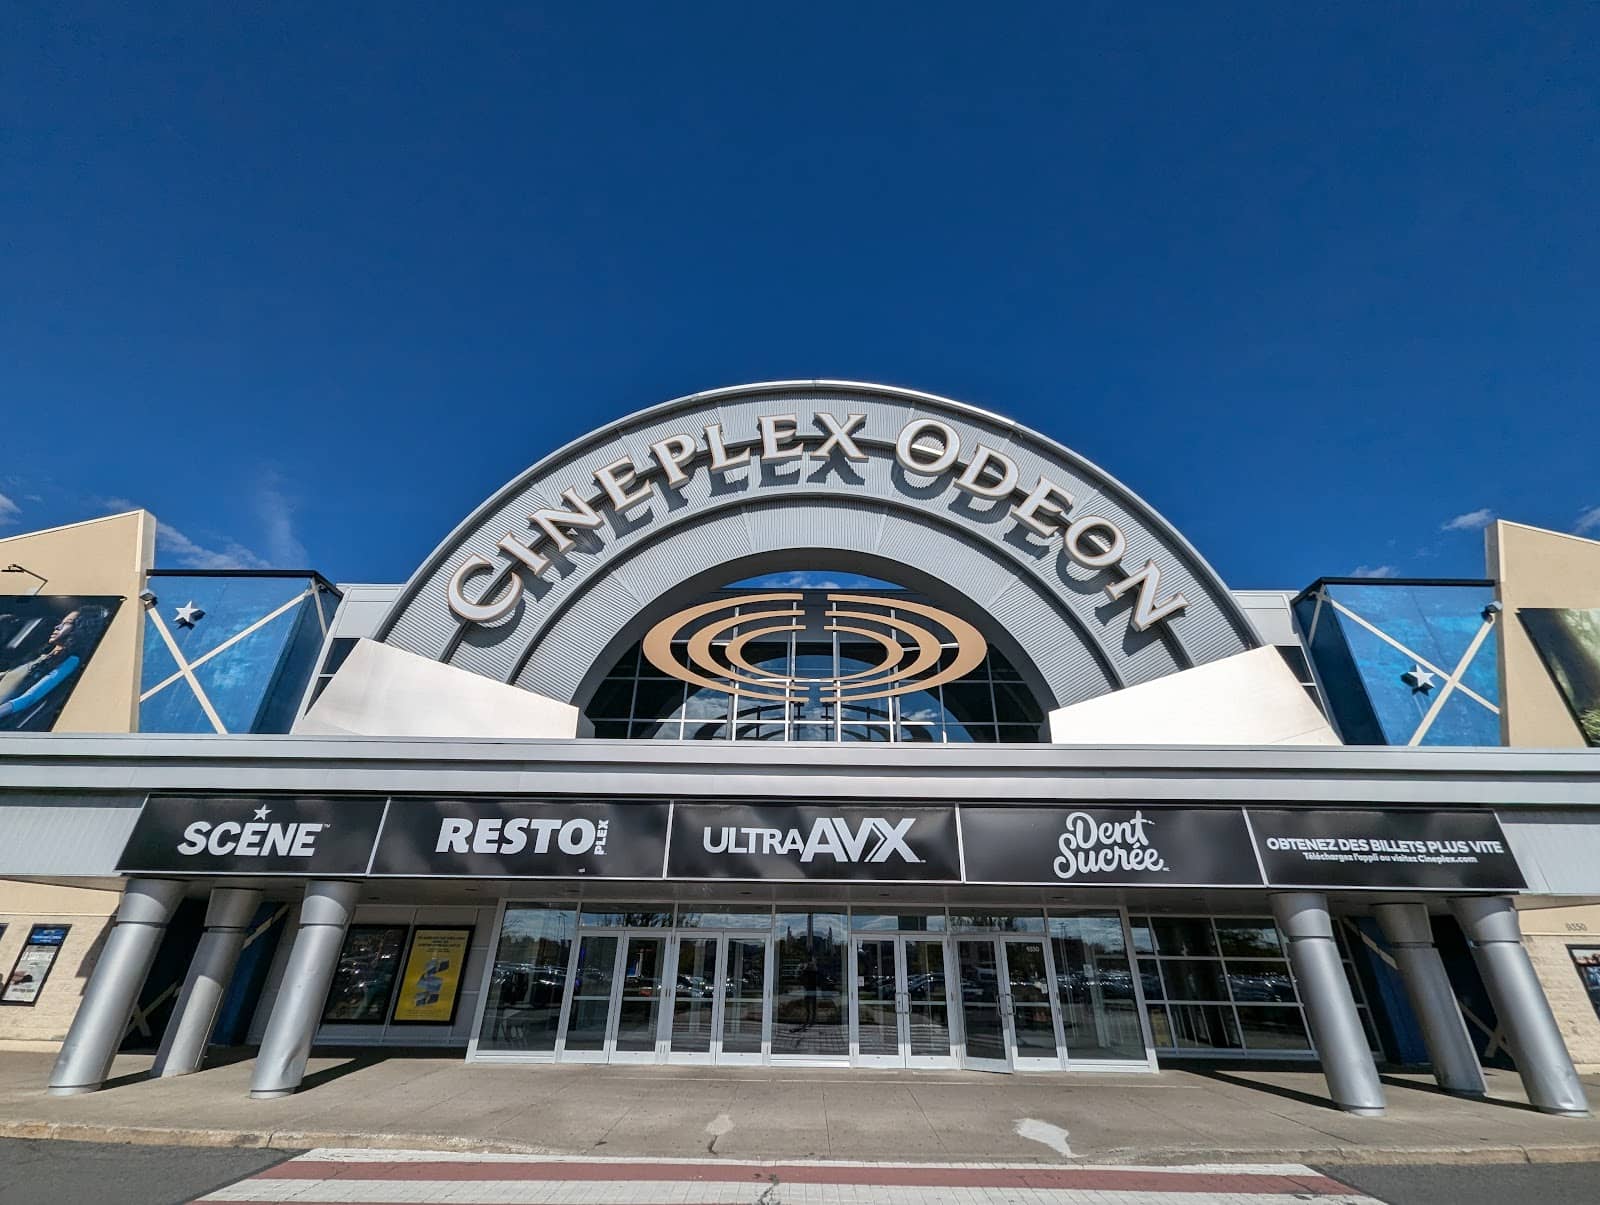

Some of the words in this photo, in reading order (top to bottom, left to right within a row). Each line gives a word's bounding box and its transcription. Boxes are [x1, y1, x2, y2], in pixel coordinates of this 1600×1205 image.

[447, 412, 869, 623] CINEPLEX
[896, 418, 1191, 632] ODEON
[435, 817, 596, 855] RESTO
[594, 819, 609, 855] PLEX
[1066, 810, 1155, 848] Dent
[1266, 837, 1339, 851] OBTENEZ
[1338, 839, 1370, 852] DES
[1369, 839, 1428, 853] BILLETS
[1426, 841, 1470, 854] PLUS
[1468, 841, 1505, 854] VITE
[1053, 832, 1164, 879] Sucrée
[1417, 854, 1479, 865] Cineplex.com
